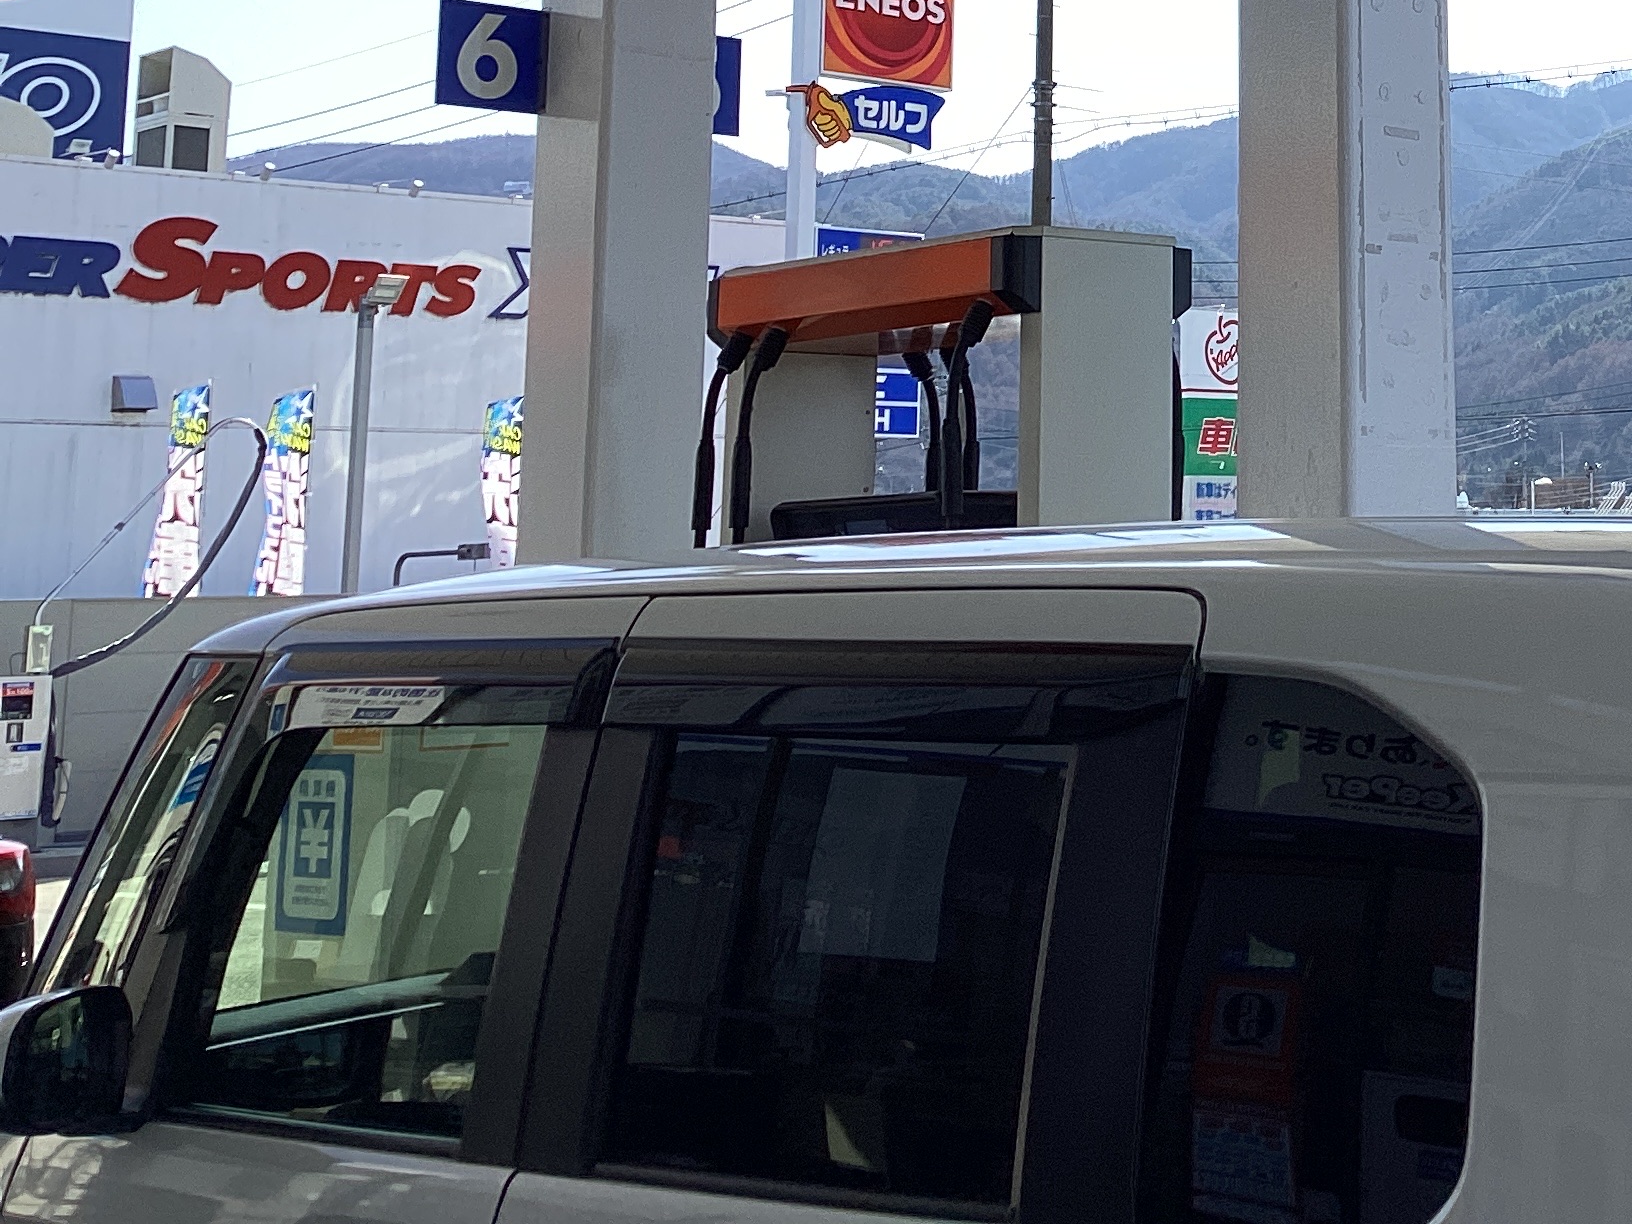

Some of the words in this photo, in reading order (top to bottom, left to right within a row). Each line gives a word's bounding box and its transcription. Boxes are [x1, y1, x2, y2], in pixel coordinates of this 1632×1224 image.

[456, 14, 518, 99] 6
[852, 93, 931, 134] セルフ
[0, 235, 121, 298] ER
[114, 216, 482, 318] SPORTS
[821, 244, 851, 258] レギュラ
[1197, 417, 1238, 457] 車
